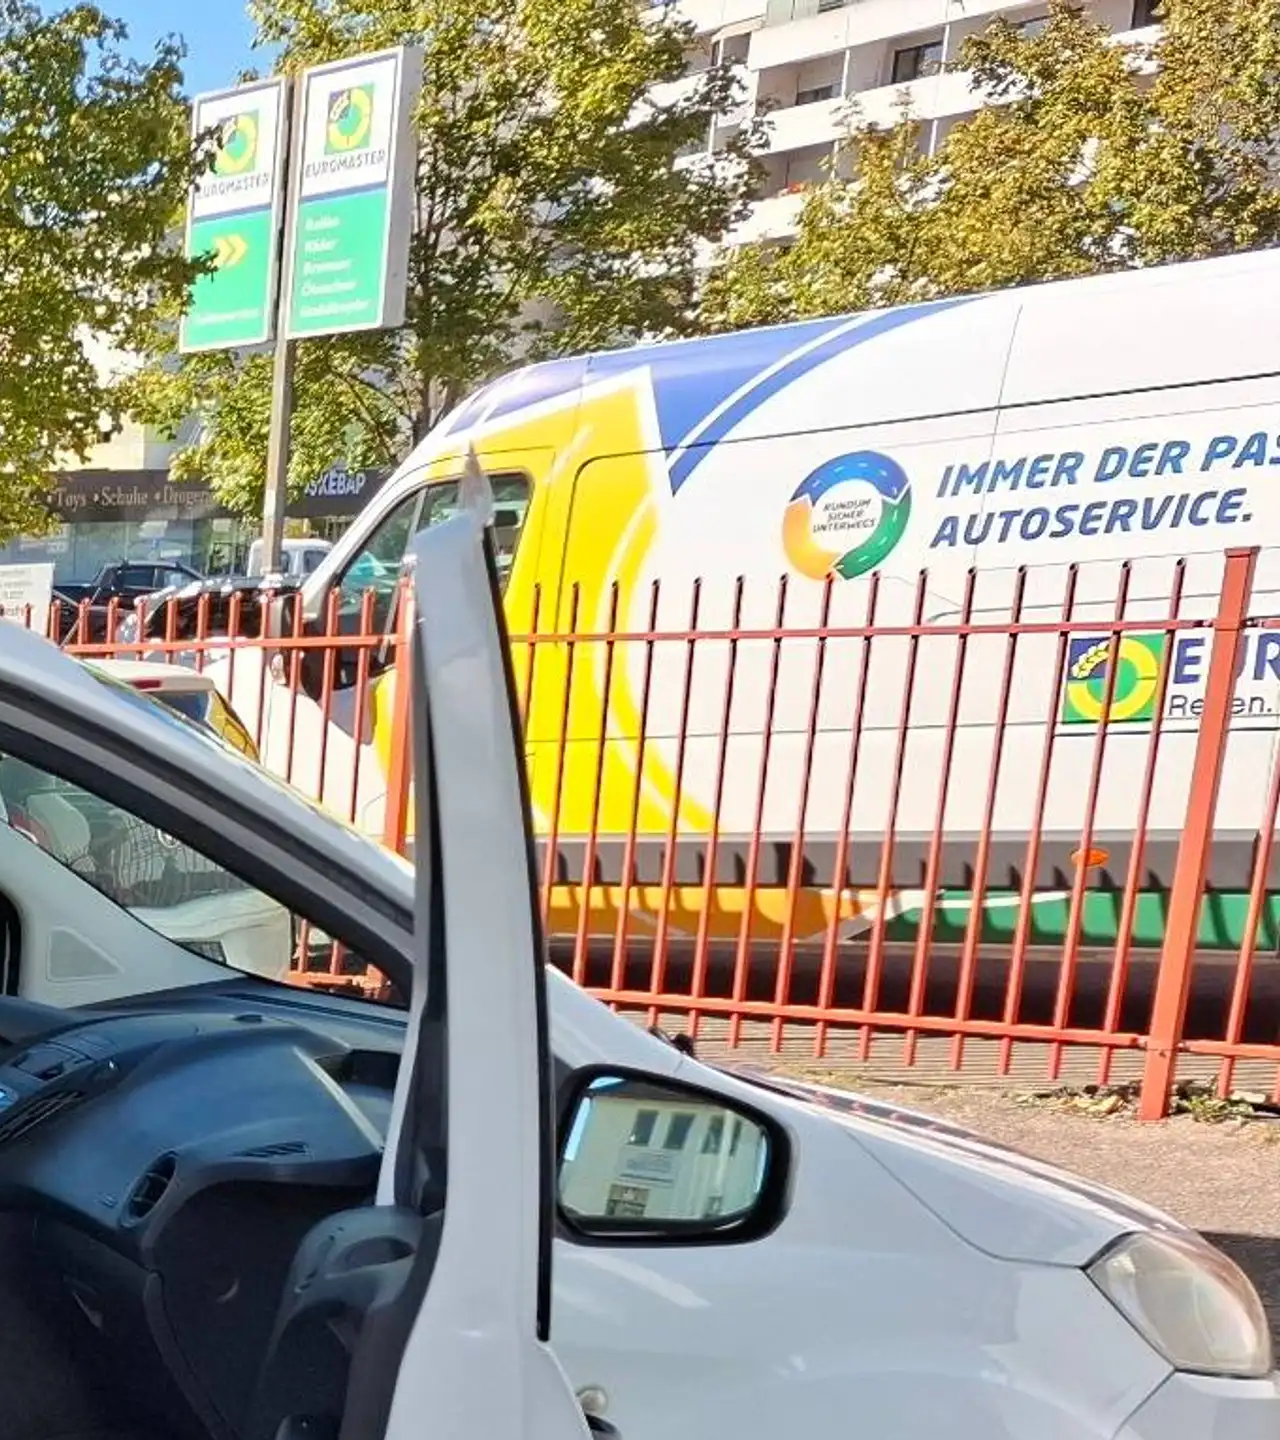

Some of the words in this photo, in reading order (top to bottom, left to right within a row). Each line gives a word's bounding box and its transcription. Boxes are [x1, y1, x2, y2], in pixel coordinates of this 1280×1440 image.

[304, 148, 386, 179] EUROMASTER
[936, 451, 1085, 498] IMMER
[1093, 439, 1191, 483] DER
[929, 487, 1254, 549] AUTOSERVICE.
